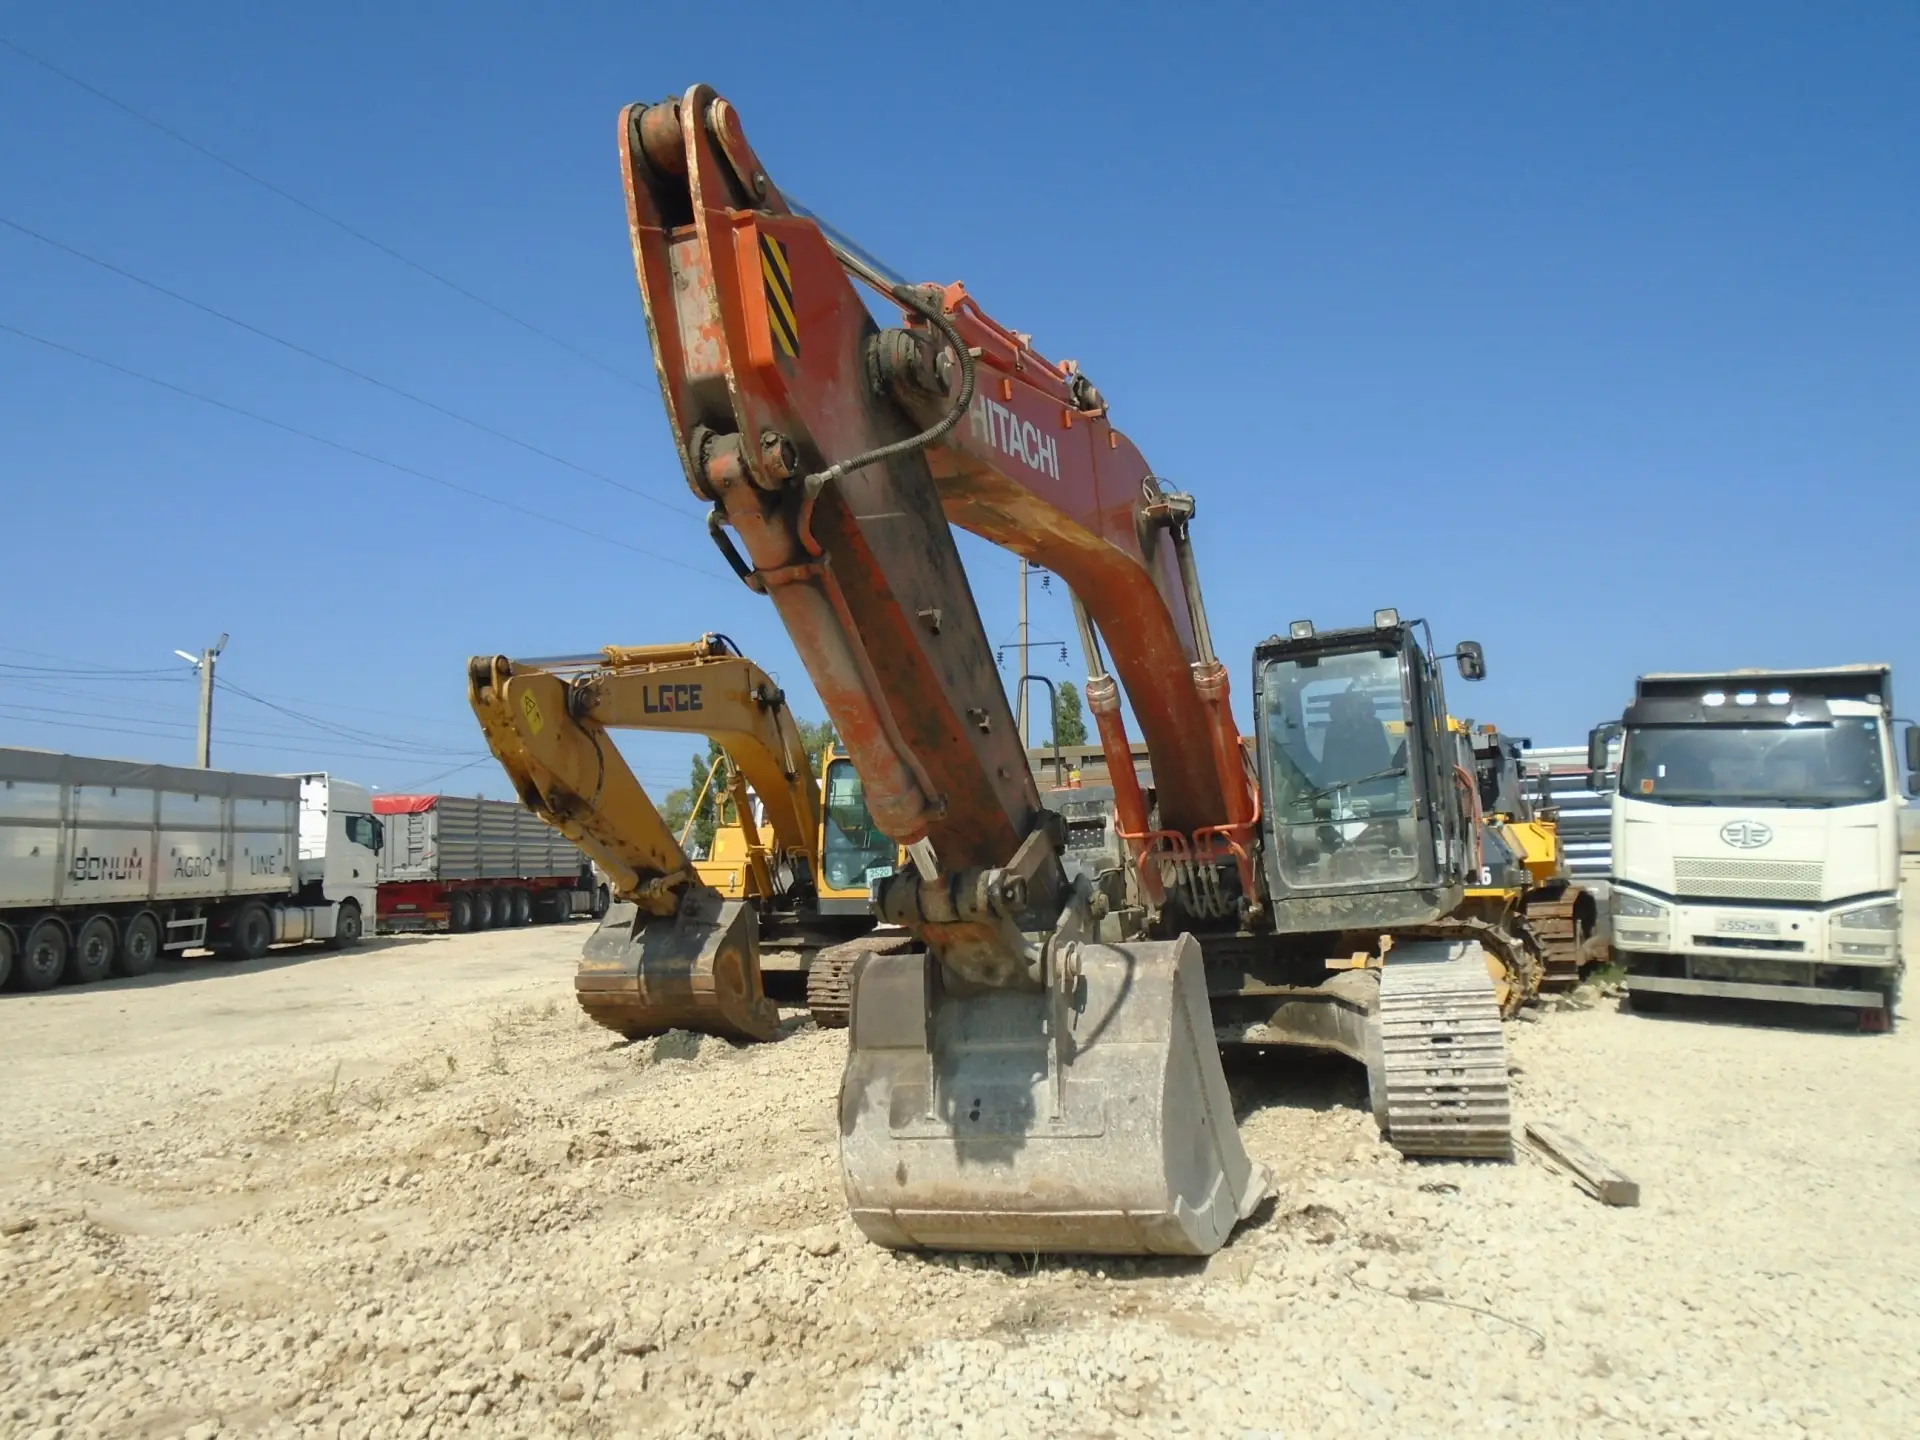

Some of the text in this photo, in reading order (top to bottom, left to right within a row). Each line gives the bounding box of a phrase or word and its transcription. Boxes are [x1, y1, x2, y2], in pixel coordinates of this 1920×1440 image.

[970, 394, 1060, 481] HITACHI
[75, 855, 275, 881] BONUM AGRO LINE
